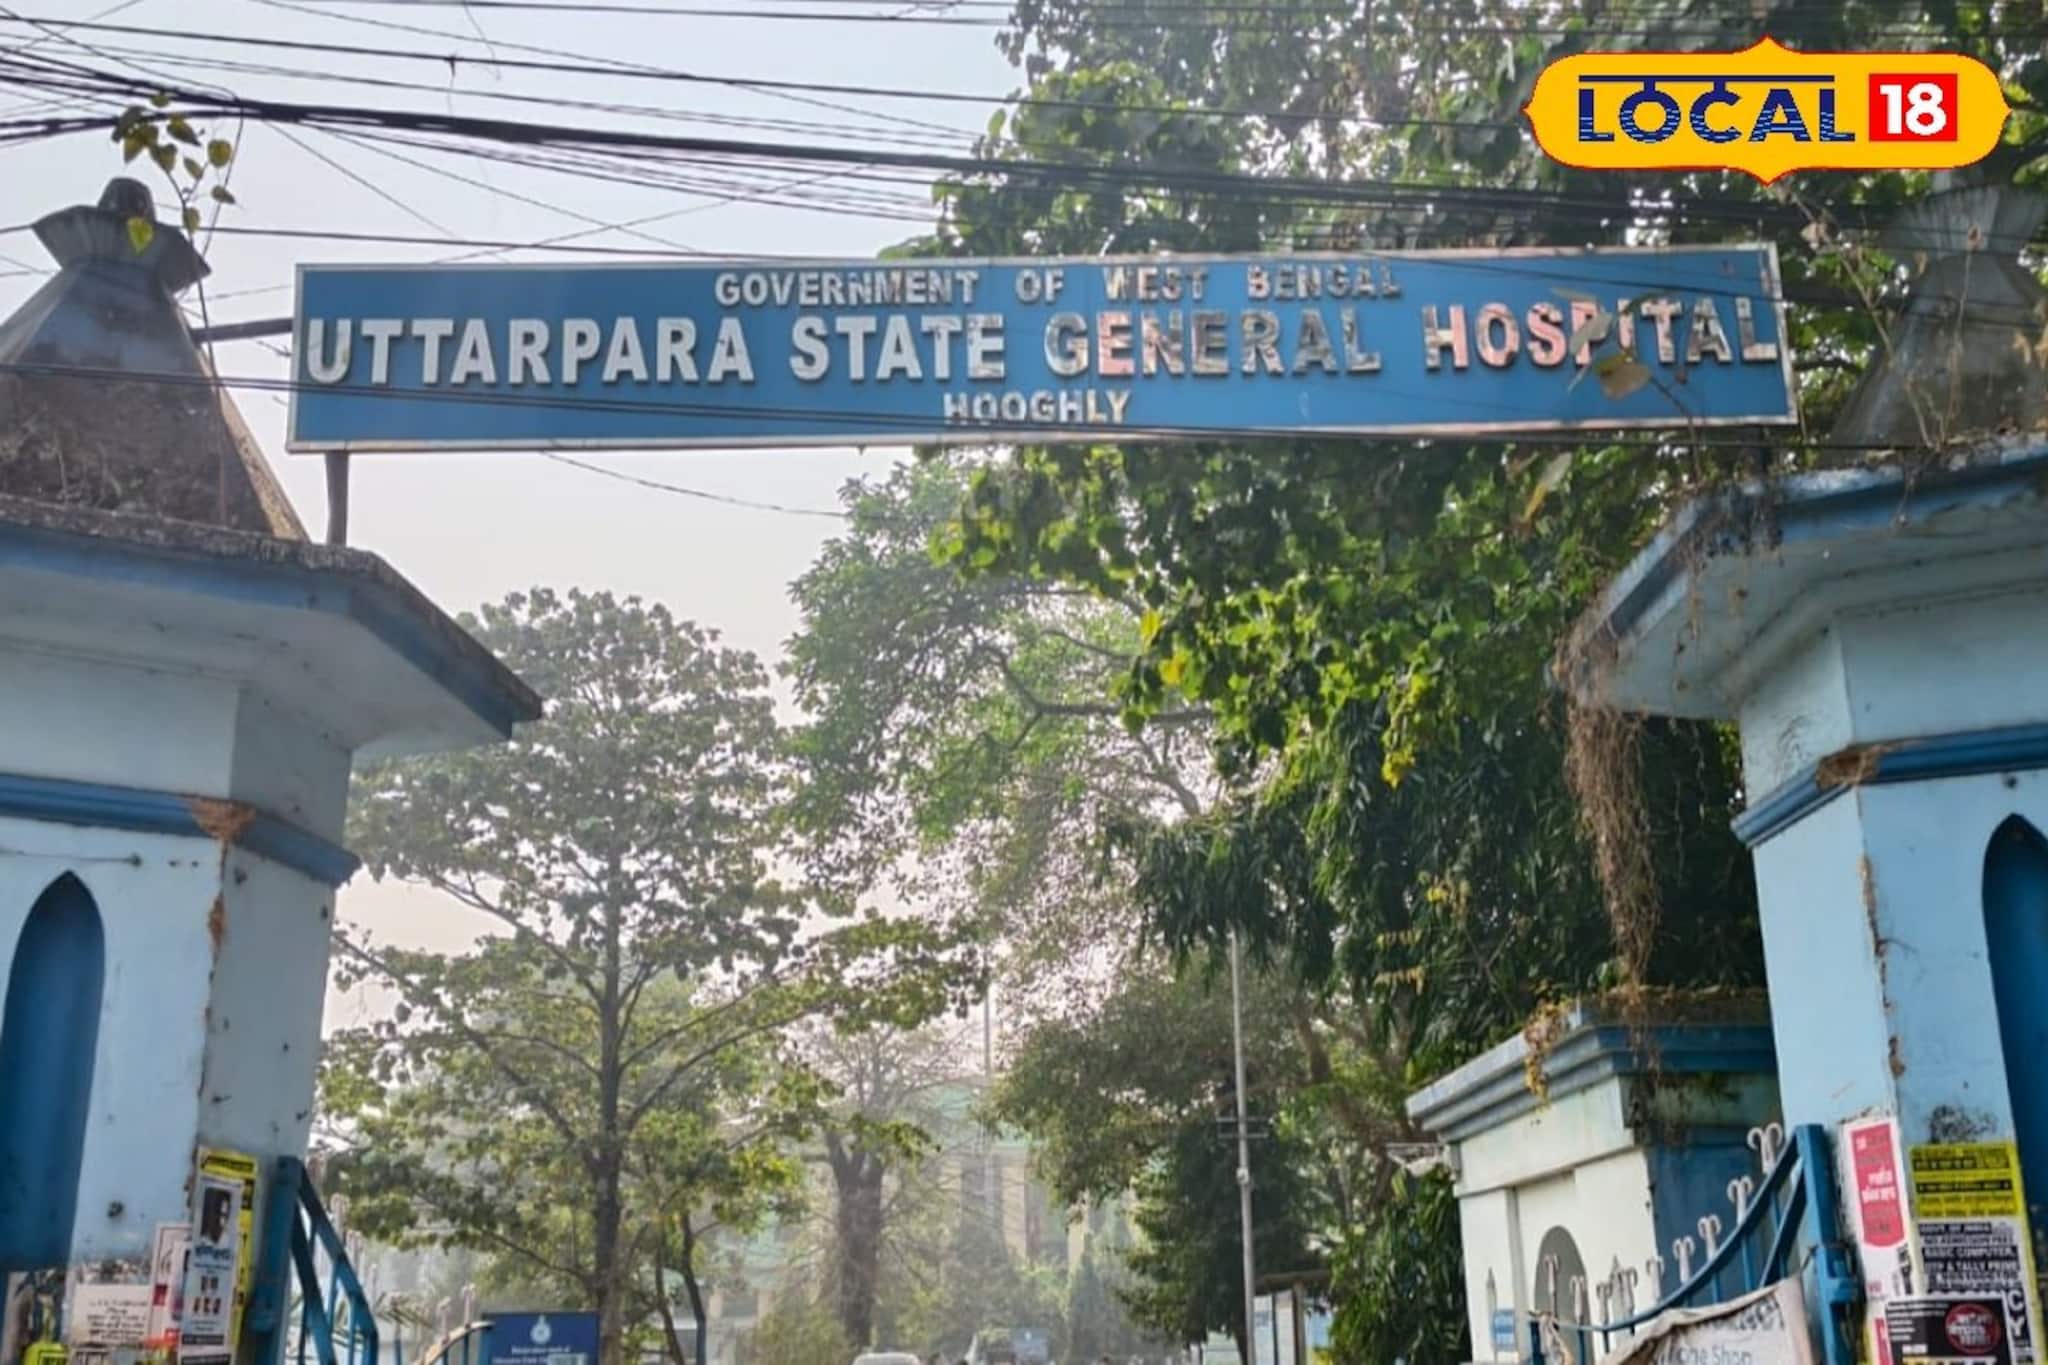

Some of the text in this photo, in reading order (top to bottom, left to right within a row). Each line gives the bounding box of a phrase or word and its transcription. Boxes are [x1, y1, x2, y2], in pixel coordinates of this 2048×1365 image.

[715, 261, 1402, 307] GOVERNMENT OF WEST BENGAL
[306, 296, 1778, 386] UTTARPARA STATE GENERAL HOSPITAL
[942, 389, 1131, 427] HOOGHLY
